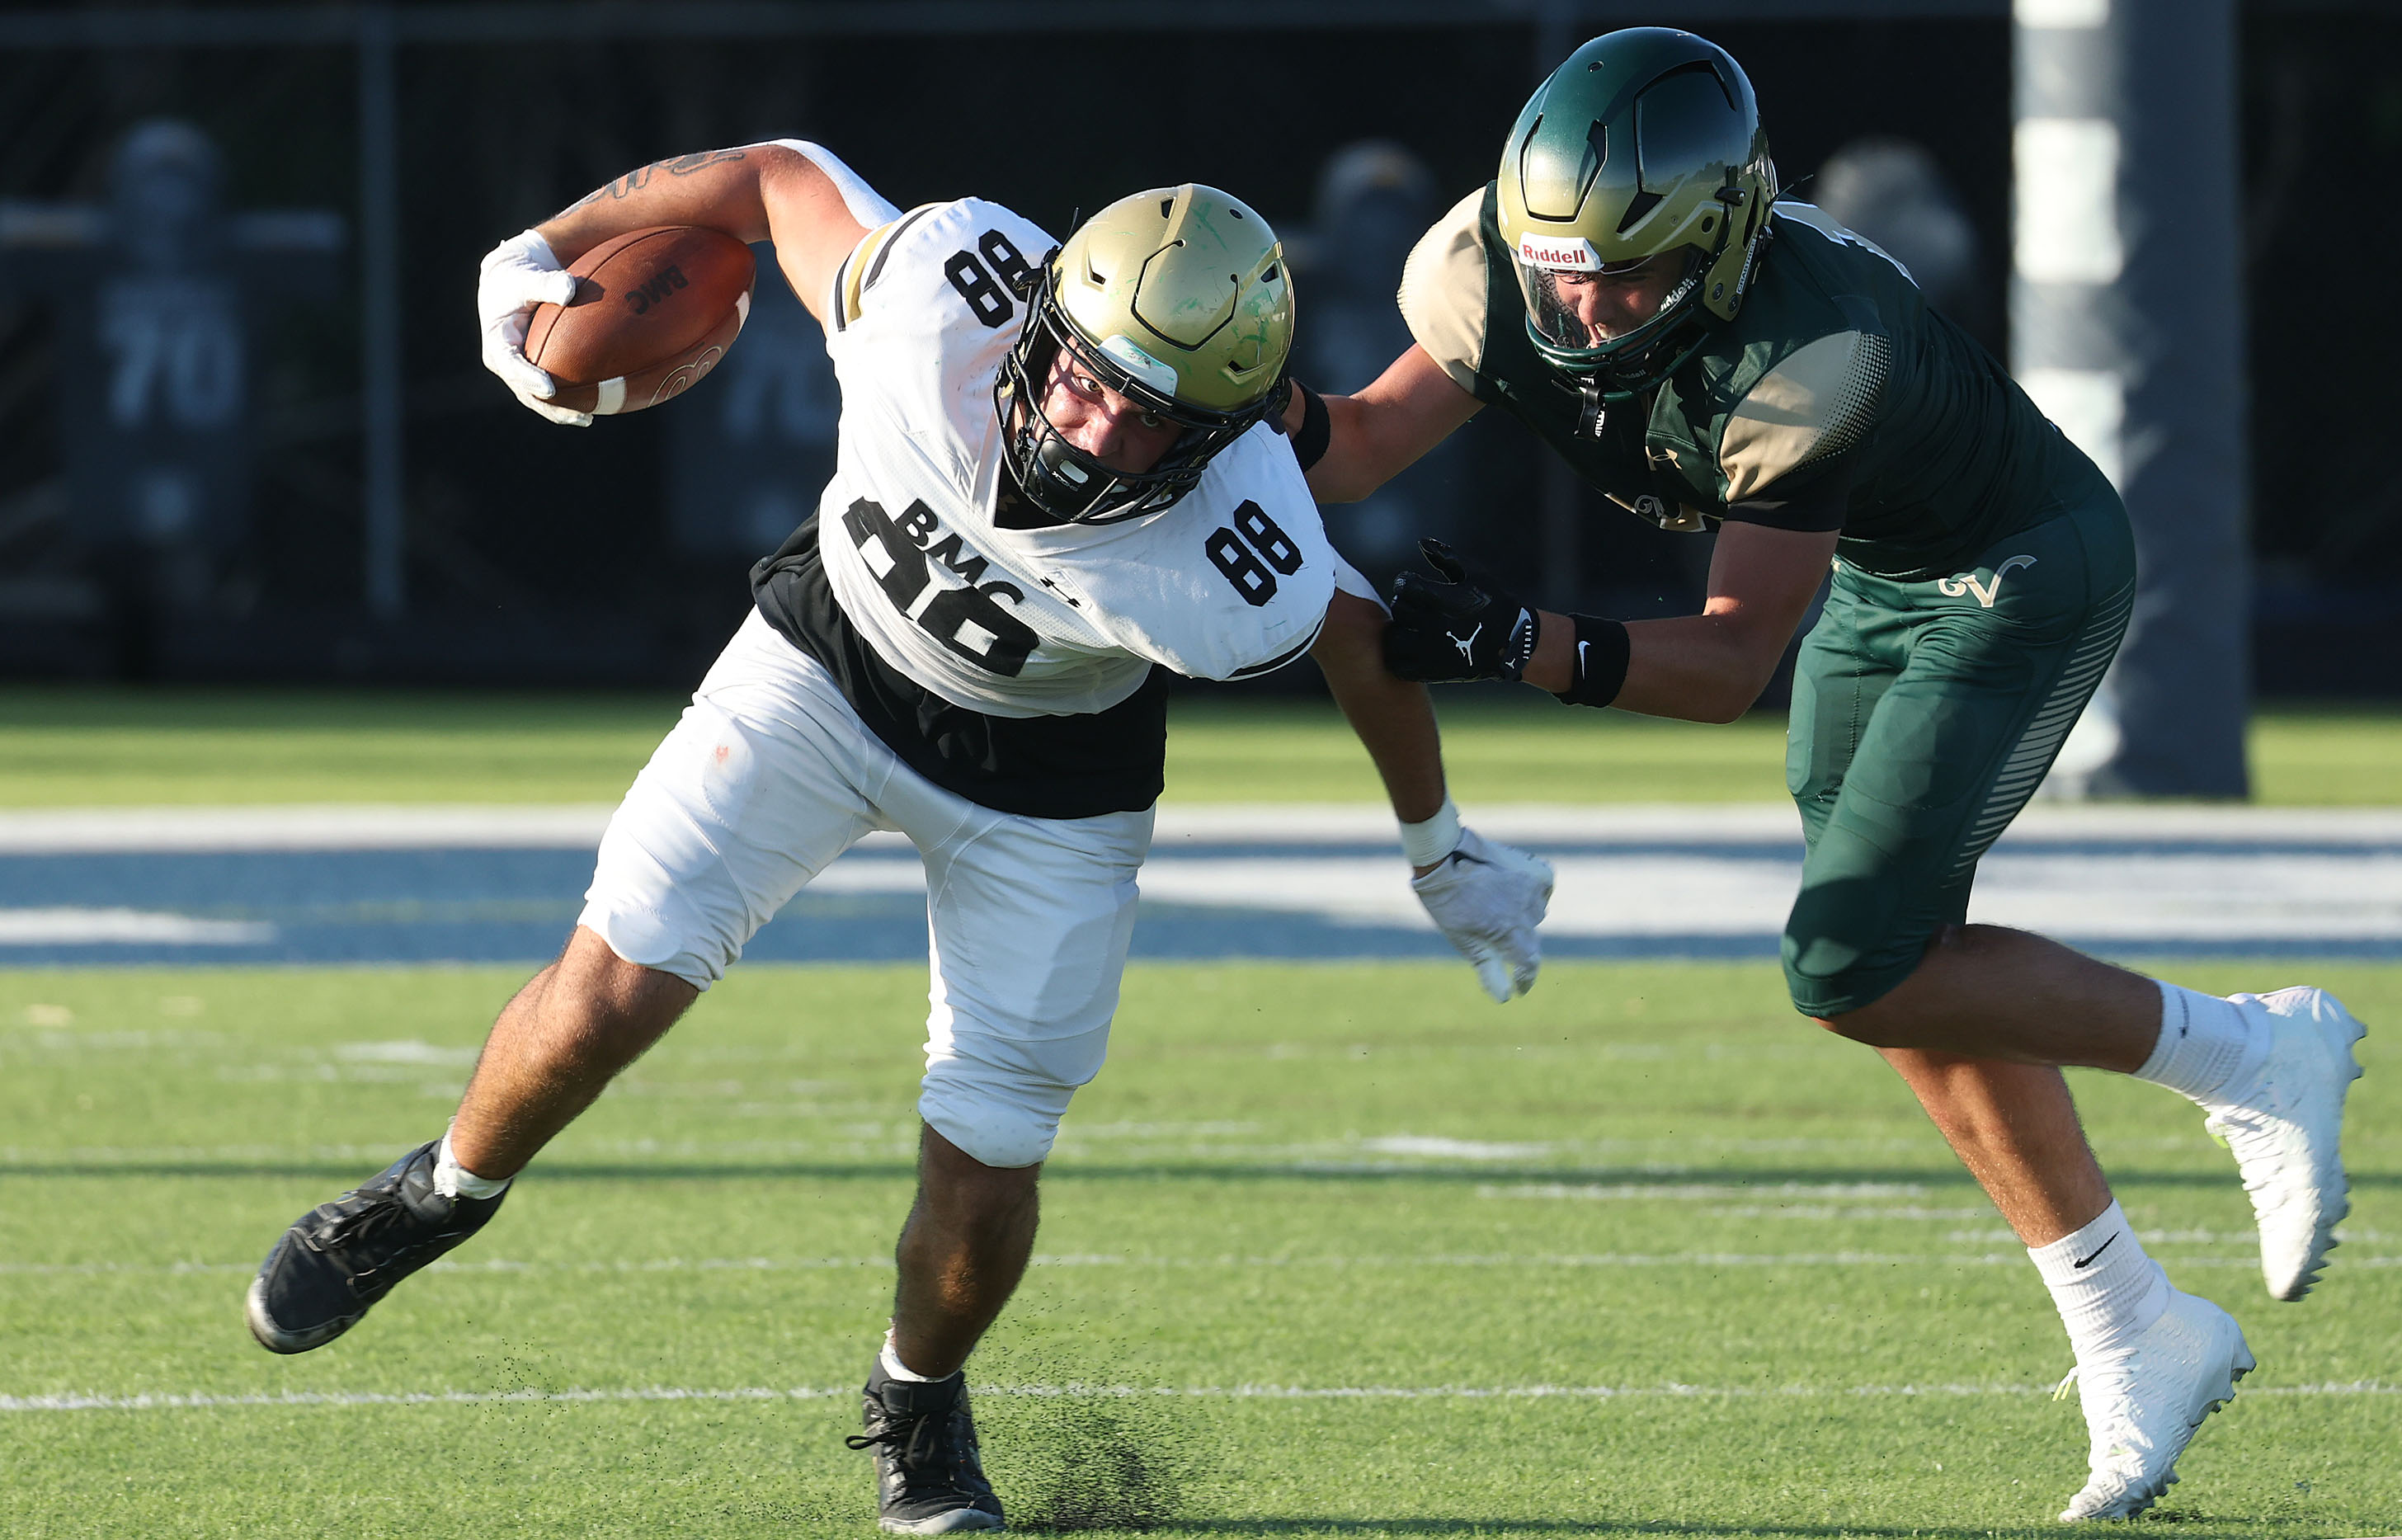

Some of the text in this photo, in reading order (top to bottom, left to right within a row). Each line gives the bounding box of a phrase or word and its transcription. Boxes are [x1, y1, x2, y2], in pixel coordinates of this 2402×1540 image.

[624, 265, 690, 315] BMC
[944, 228, 1028, 328] 88
[1523, 244, 1585, 263] Riddell
[895, 498, 1025, 605] BMC
[1205, 499, 1303, 606] 88
[1523, 624, 1532, 660] JORDAN
